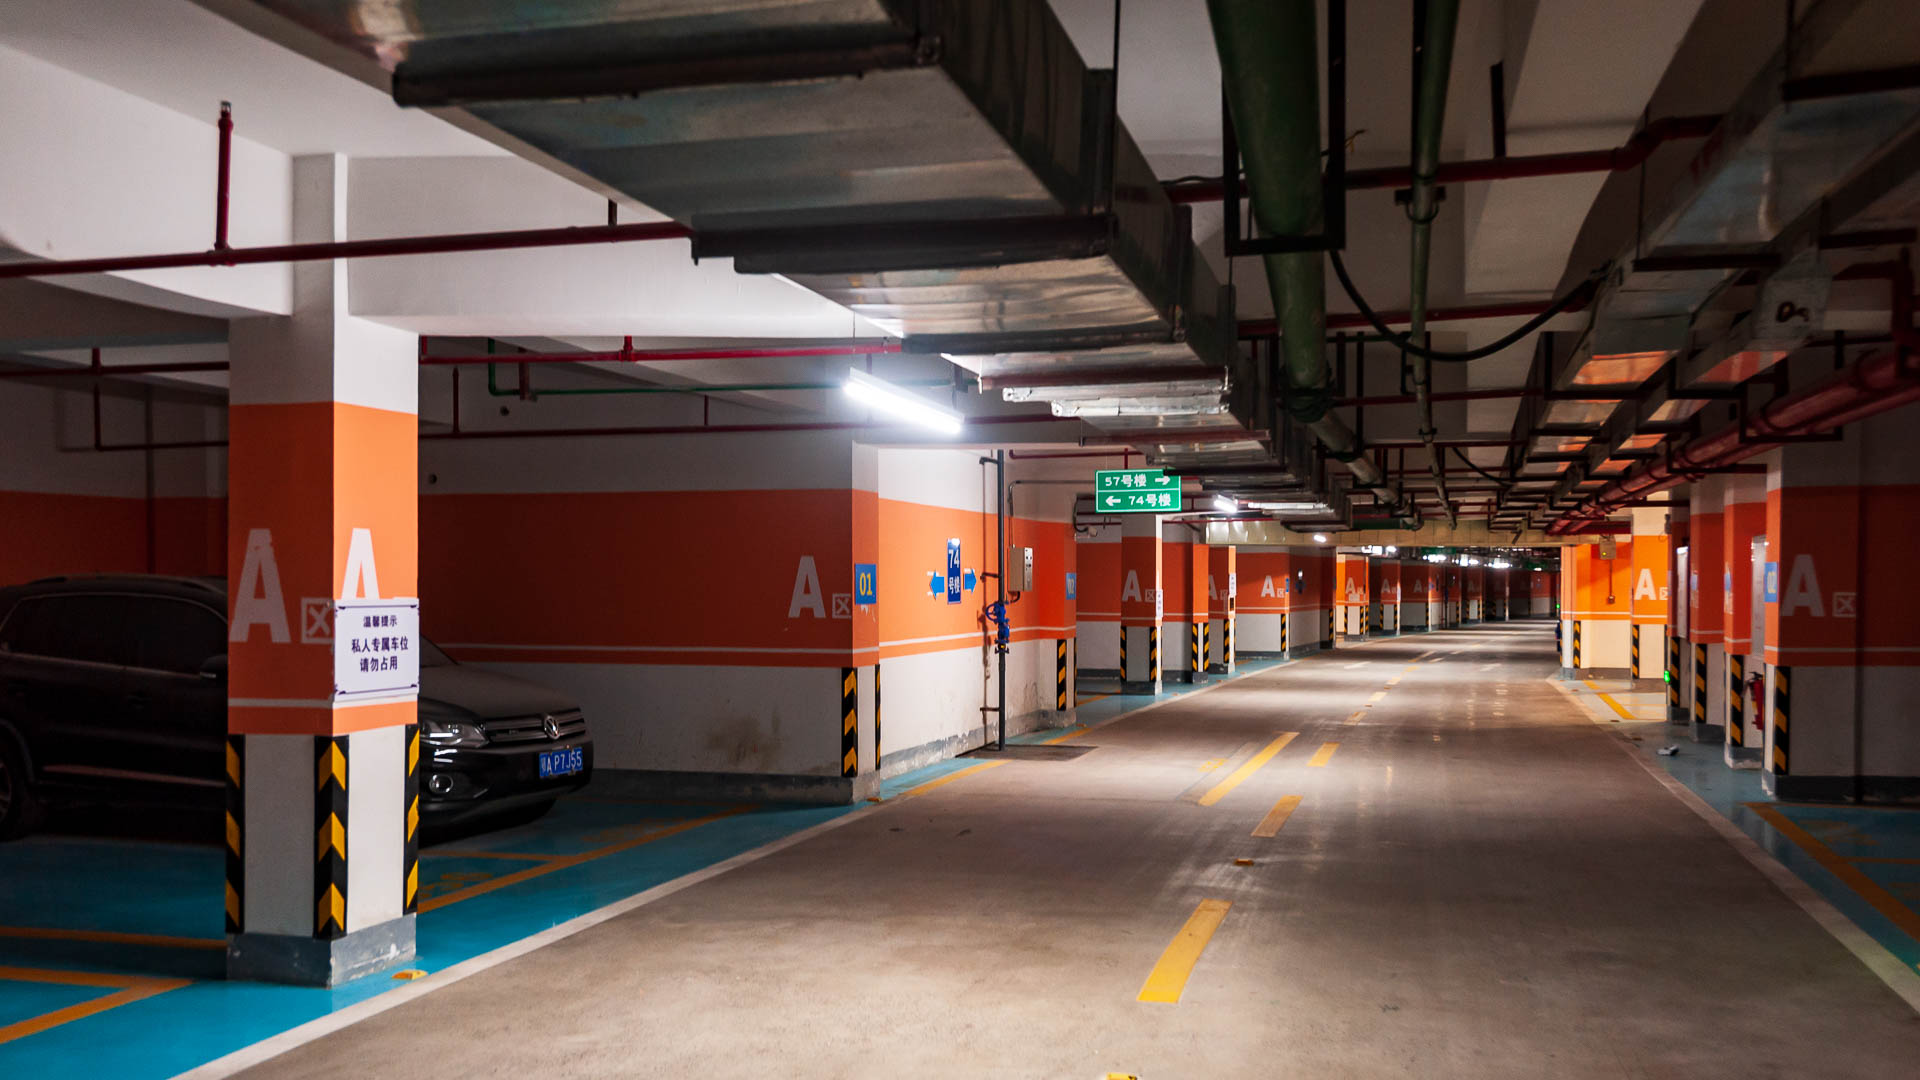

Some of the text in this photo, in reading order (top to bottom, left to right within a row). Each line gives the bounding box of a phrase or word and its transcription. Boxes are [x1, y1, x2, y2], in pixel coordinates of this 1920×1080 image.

[1105, 474, 1147, 487] 57号楼
[1128, 493, 1171, 507] 74号楼
[948, 549, 960, 568] 74
[859, 572, 873, 596] 01
[363, 615, 398, 628] 温馨提示
[351, 636, 409, 653] 私人专属车位
[360, 656, 398, 673] 请勿占用
